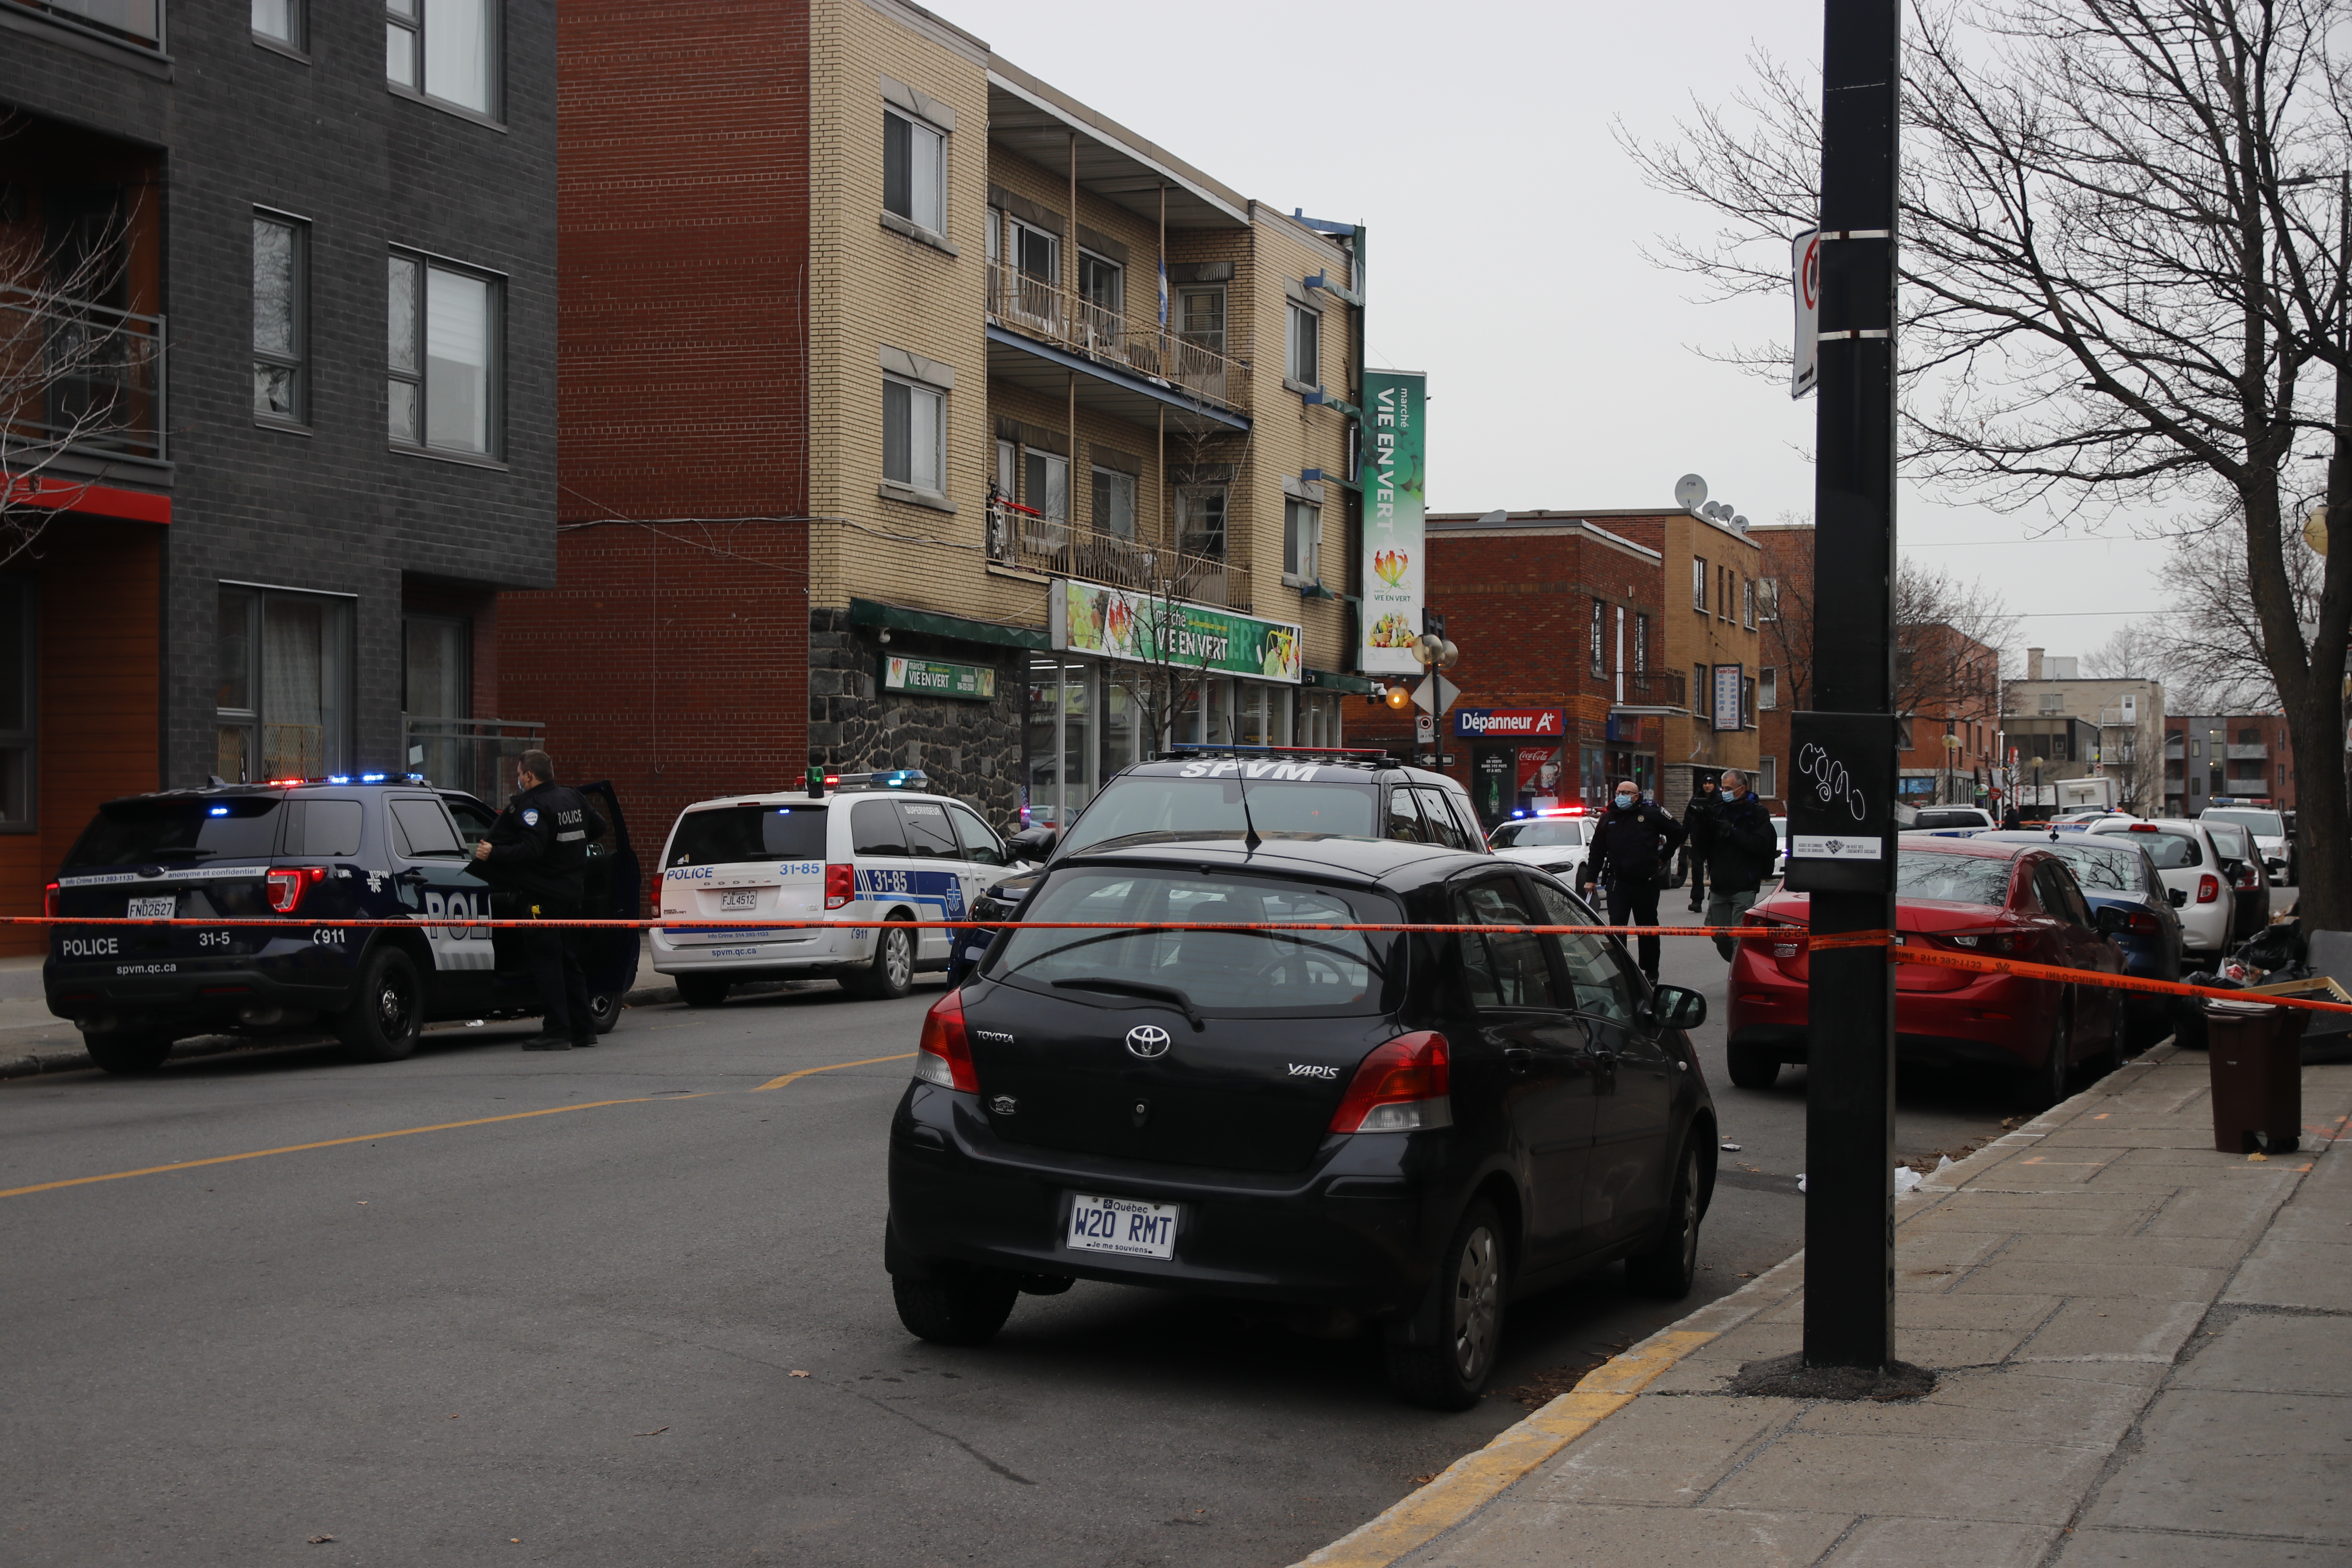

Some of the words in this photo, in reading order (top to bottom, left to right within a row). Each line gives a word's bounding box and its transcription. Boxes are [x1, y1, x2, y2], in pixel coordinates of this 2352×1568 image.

[1377, 387, 1395, 427] VIE
[1401, 388, 1410, 432] marché
[1377, 433, 1394, 465] EN
[1377, 470, 1394, 533] VERT
[1156, 609, 1186, 628] maché
[1156, 627, 1176, 653] VE
[1179, 630, 1196, 656] EN
[1197, 633, 1228, 661] VERT
[909, 661, 926, 671] marché
[909, 671, 920, 686] VIE
[921, 673, 931, 687] EN
[931, 673, 949, 688] VERT
[1462, 712, 1532, 733] Dépanneur
[1180, 762, 1320, 781] SPVM
[558, 809, 583, 826] POLICE
[905, 806, 942, 816] SUPERVISEUR
[374, 870, 390, 879] SPVM
[667, 867, 714, 880] POLICE
[780, 863, 820, 875] 31-85
[874, 870, 907, 891] 31-85
[722, 895, 755, 905] FJL4512
[130, 903, 173, 917] FND2627
[200, 932, 230, 946] 31-5
[322, 929, 345, 944] 911
[856, 928, 867, 939] 911
[63, 938, 118, 956] POLICE
[712, 948, 756, 957] spvm.qc.ca
[117, 964, 176, 975] spvm.qc.ca
[977, 1031, 1014, 1044] TOYOTA
[1114, 1201, 1148, 1215] Québec
[1075, 1207, 1116, 1237] W20
[1129, 1213, 1172, 1244] RMT
[1115, 1244, 1148, 1254] souviens
